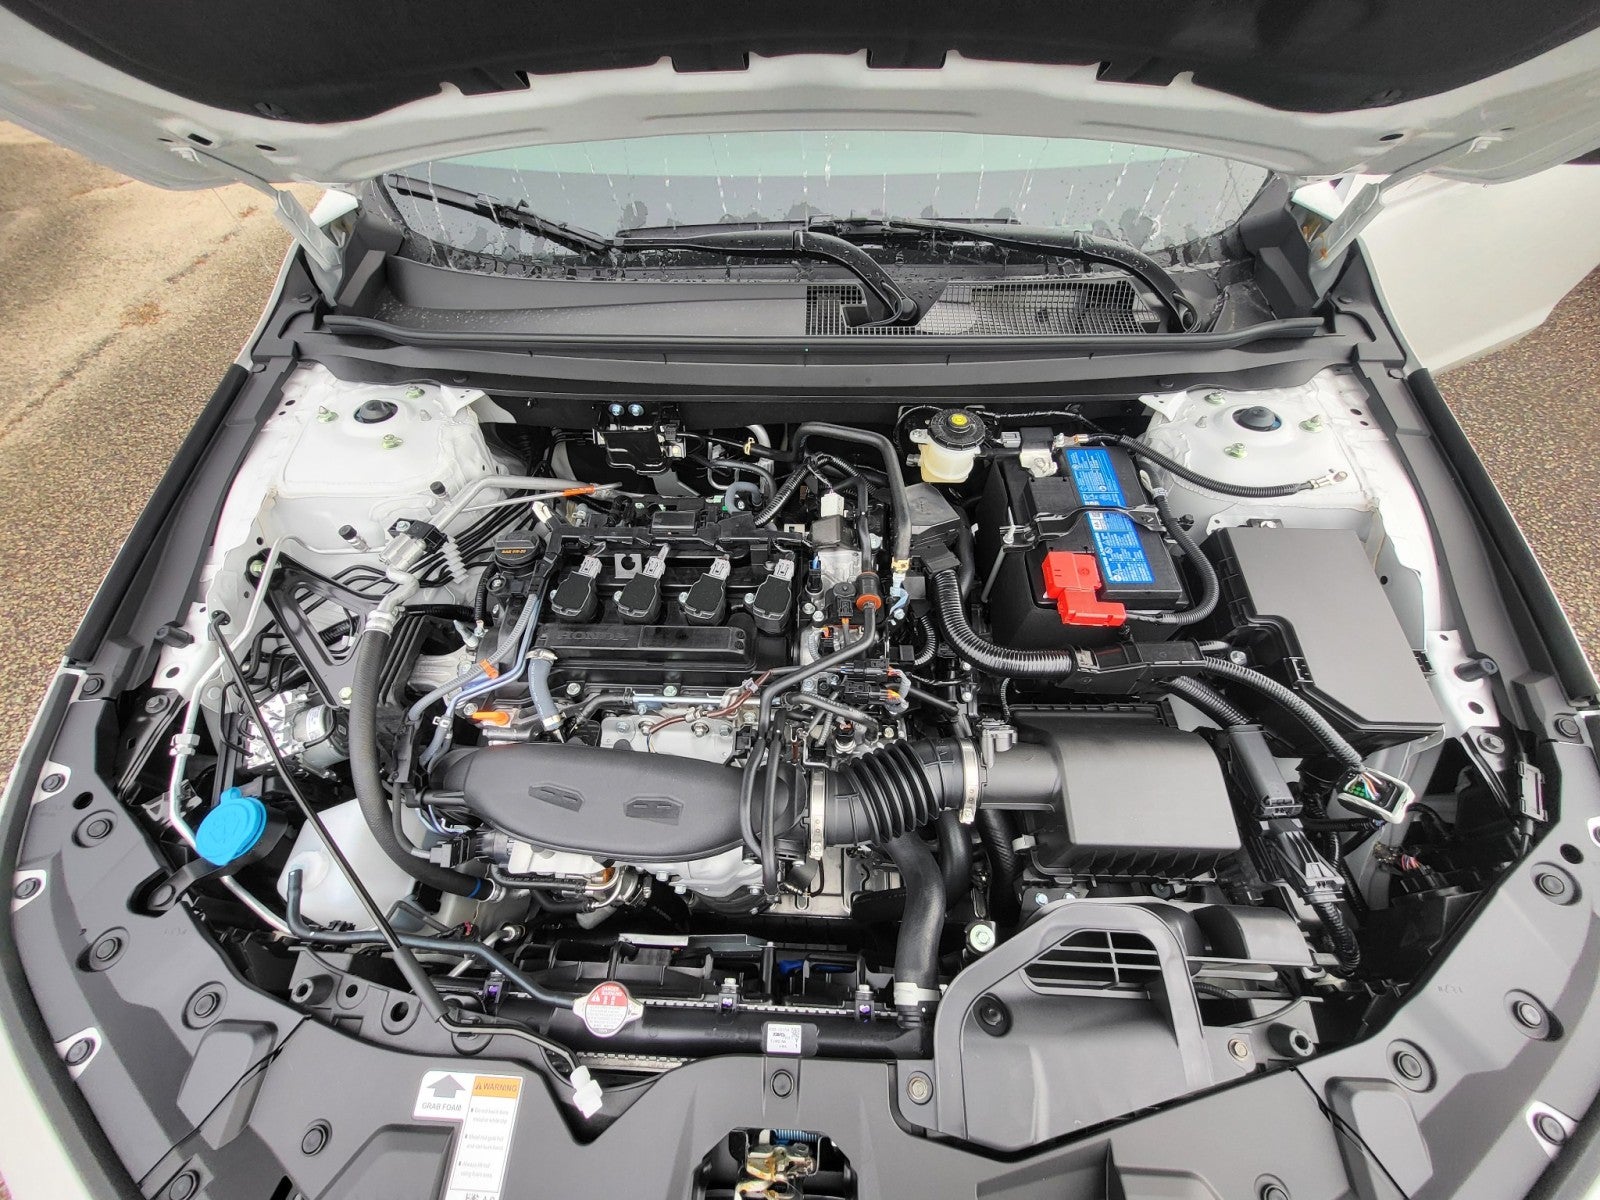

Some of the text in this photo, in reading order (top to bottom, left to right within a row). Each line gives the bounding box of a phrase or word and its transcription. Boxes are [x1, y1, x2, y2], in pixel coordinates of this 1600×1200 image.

[556, 630, 629, 641] HONDA
[483, 1083, 517, 1092] WARNING
[421, 1102, 462, 1112] GRAB FOAM
